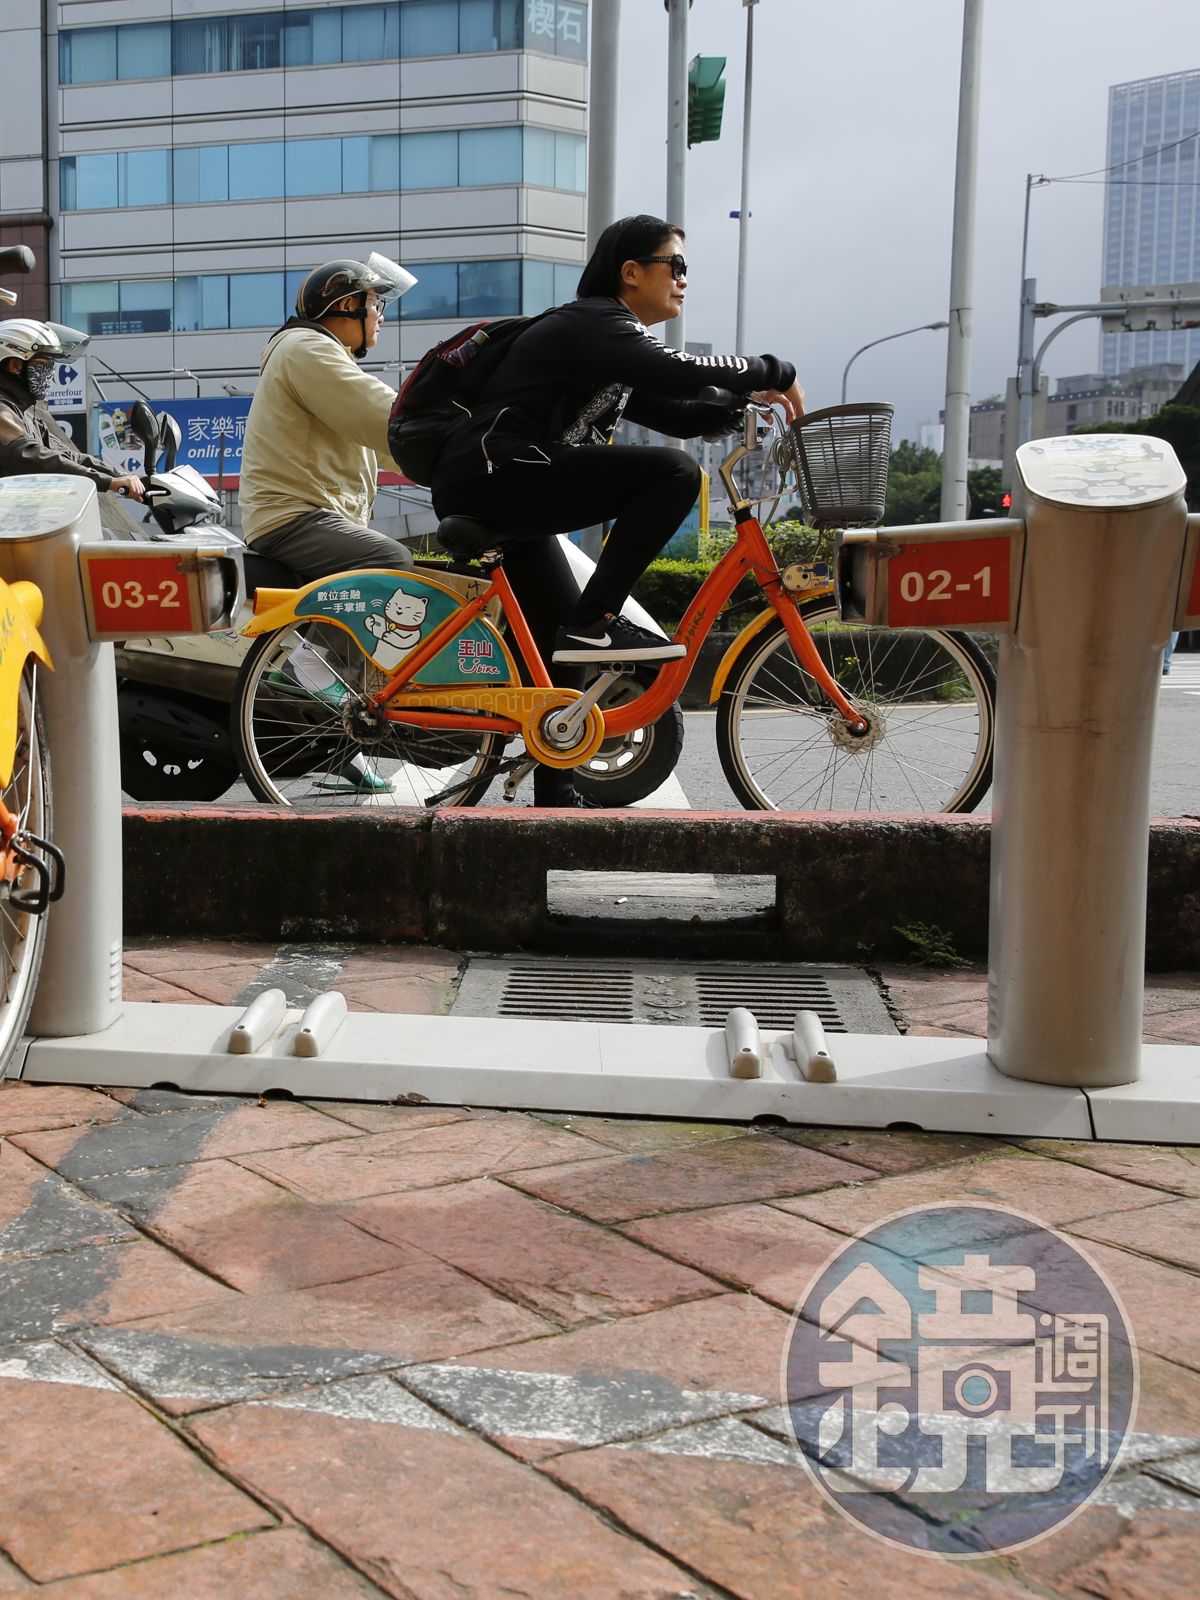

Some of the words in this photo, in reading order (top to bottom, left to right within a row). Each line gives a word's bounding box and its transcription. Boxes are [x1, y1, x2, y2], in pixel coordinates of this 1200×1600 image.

[48, 389, 83, 397] arrefour
[900, 566, 991, 602] 02-1
[102, 580, 180, 609] 03-2
[317, 589, 361, 602] 數位金融
[322, 601, 366, 614] 一手掌握
[458, 639, 493, 658] 玉山
[406, 690, 560, 713] momentum
